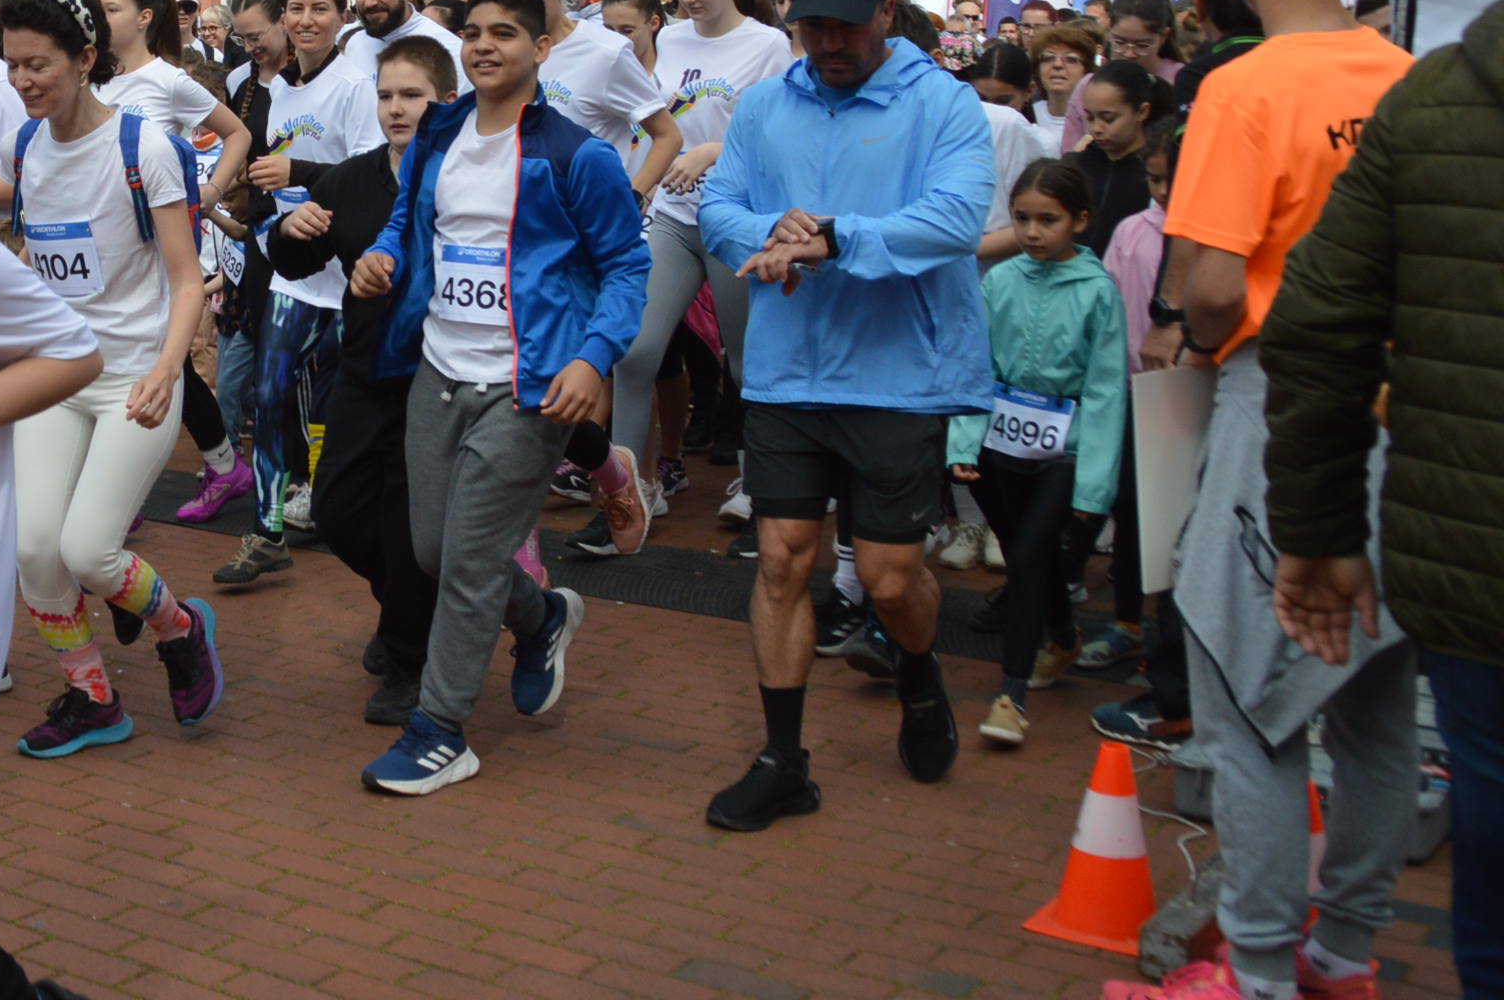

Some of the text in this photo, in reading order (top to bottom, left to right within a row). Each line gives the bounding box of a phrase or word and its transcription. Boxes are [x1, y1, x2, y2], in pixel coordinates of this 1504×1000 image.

[683, 77, 735, 98] Marathon
[282, 113, 325, 133] Marathon
[34, 252, 90, 281] 4104
[993, 413, 1059, 450] 4996
